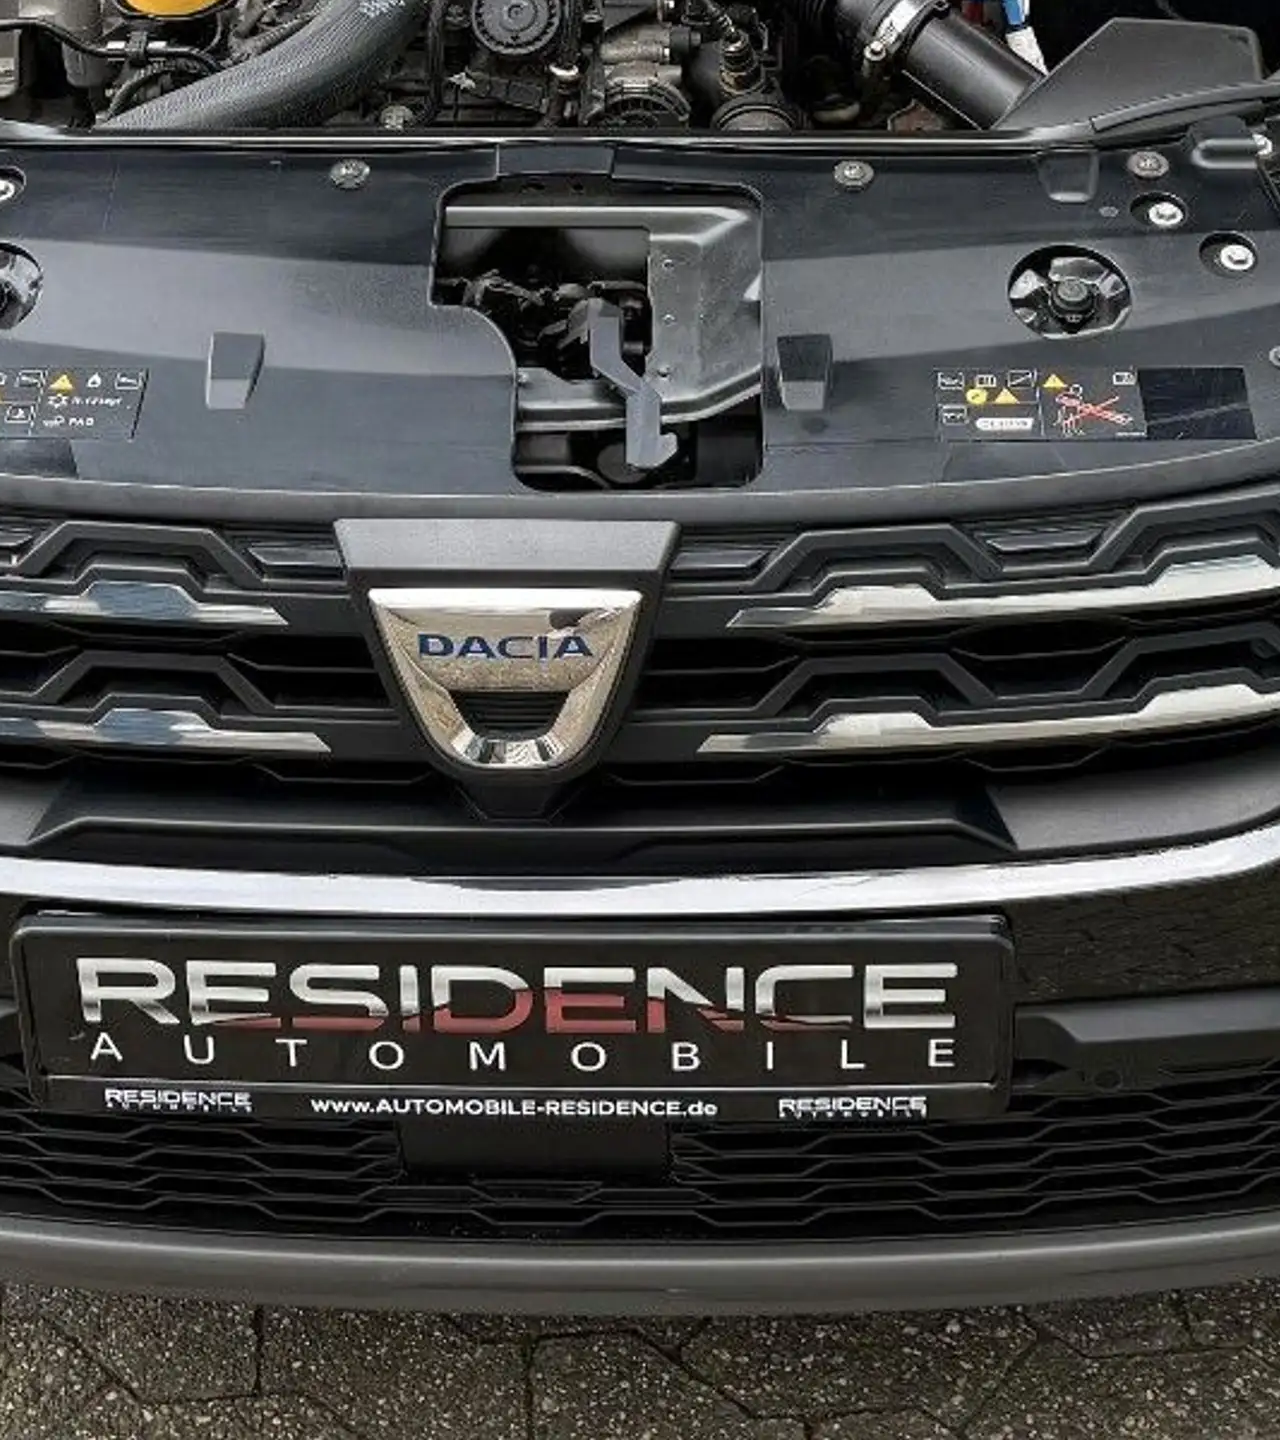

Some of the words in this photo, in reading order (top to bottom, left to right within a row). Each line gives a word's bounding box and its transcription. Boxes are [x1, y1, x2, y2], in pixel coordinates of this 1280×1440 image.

[418, 633, 594, 660] DACIA
[77, 957, 958, 1033] RESIDENCE
[89, 1034, 956, 1072] AUTOMOBILE
[104, 1088, 253, 1106] RESIDENCE
[310, 1098, 719, 1117] www.AUTOMOBILE-RESIDENCE.de
[778, 1096, 928, 1111] RESIDENCE
